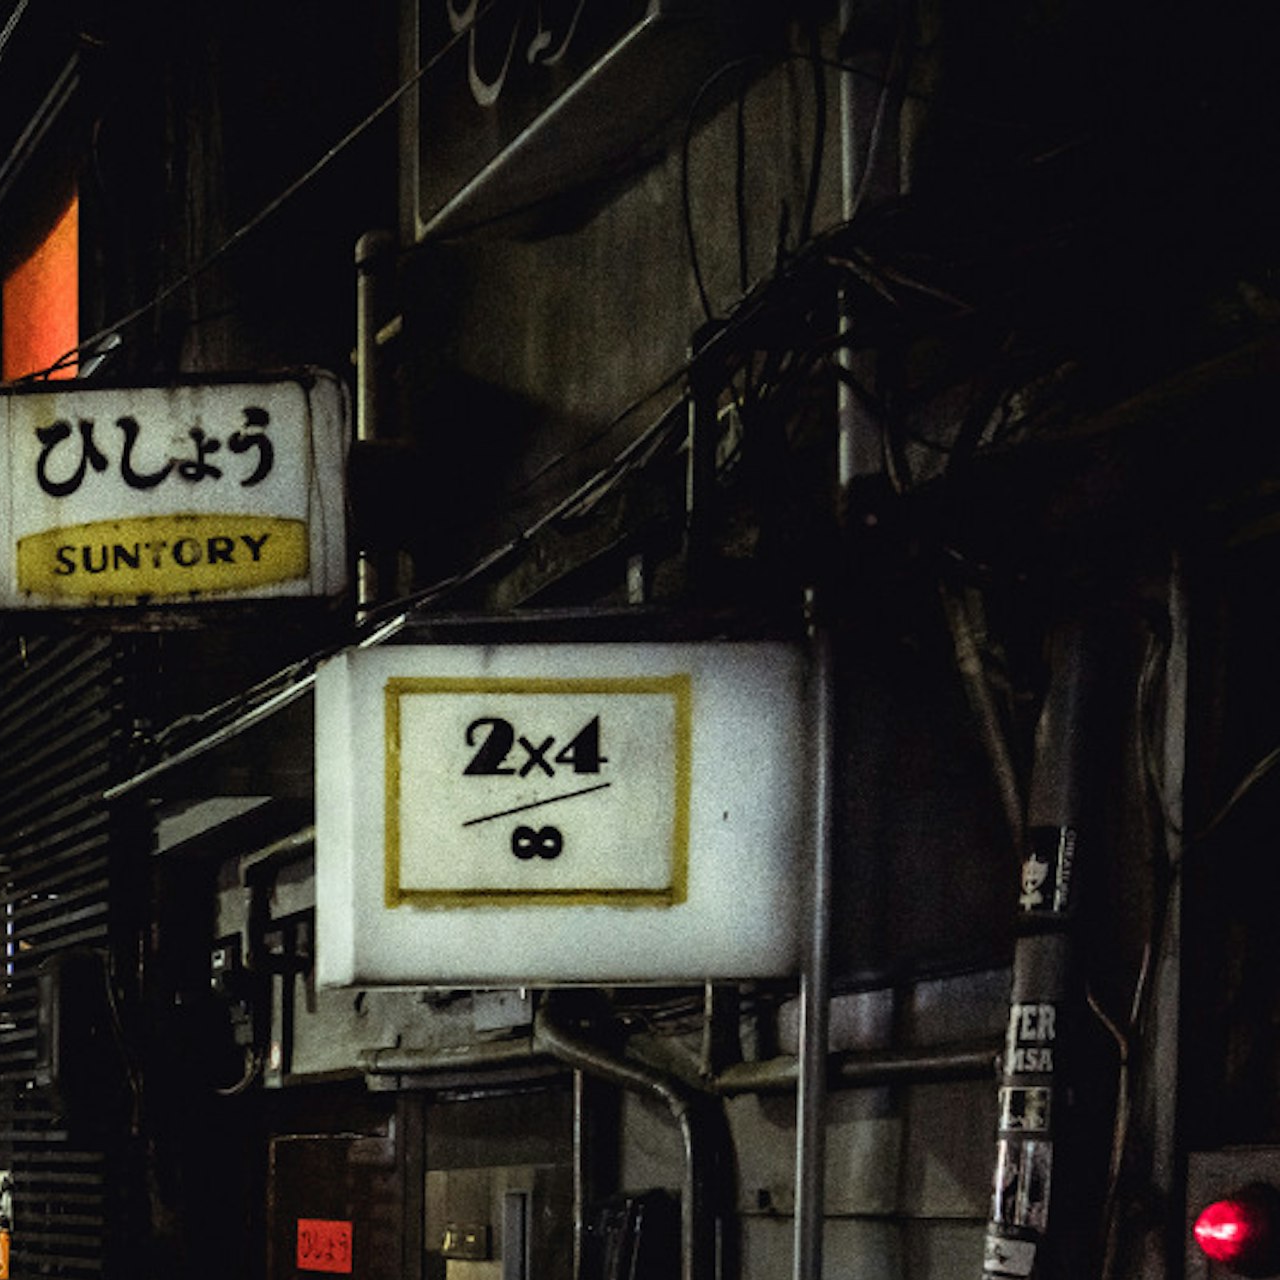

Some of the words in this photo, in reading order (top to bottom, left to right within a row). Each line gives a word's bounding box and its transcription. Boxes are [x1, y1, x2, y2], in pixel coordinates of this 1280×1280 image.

[37, 407, 274, 496] ひしょう
[53, 533, 271, 576] SUNTORY
